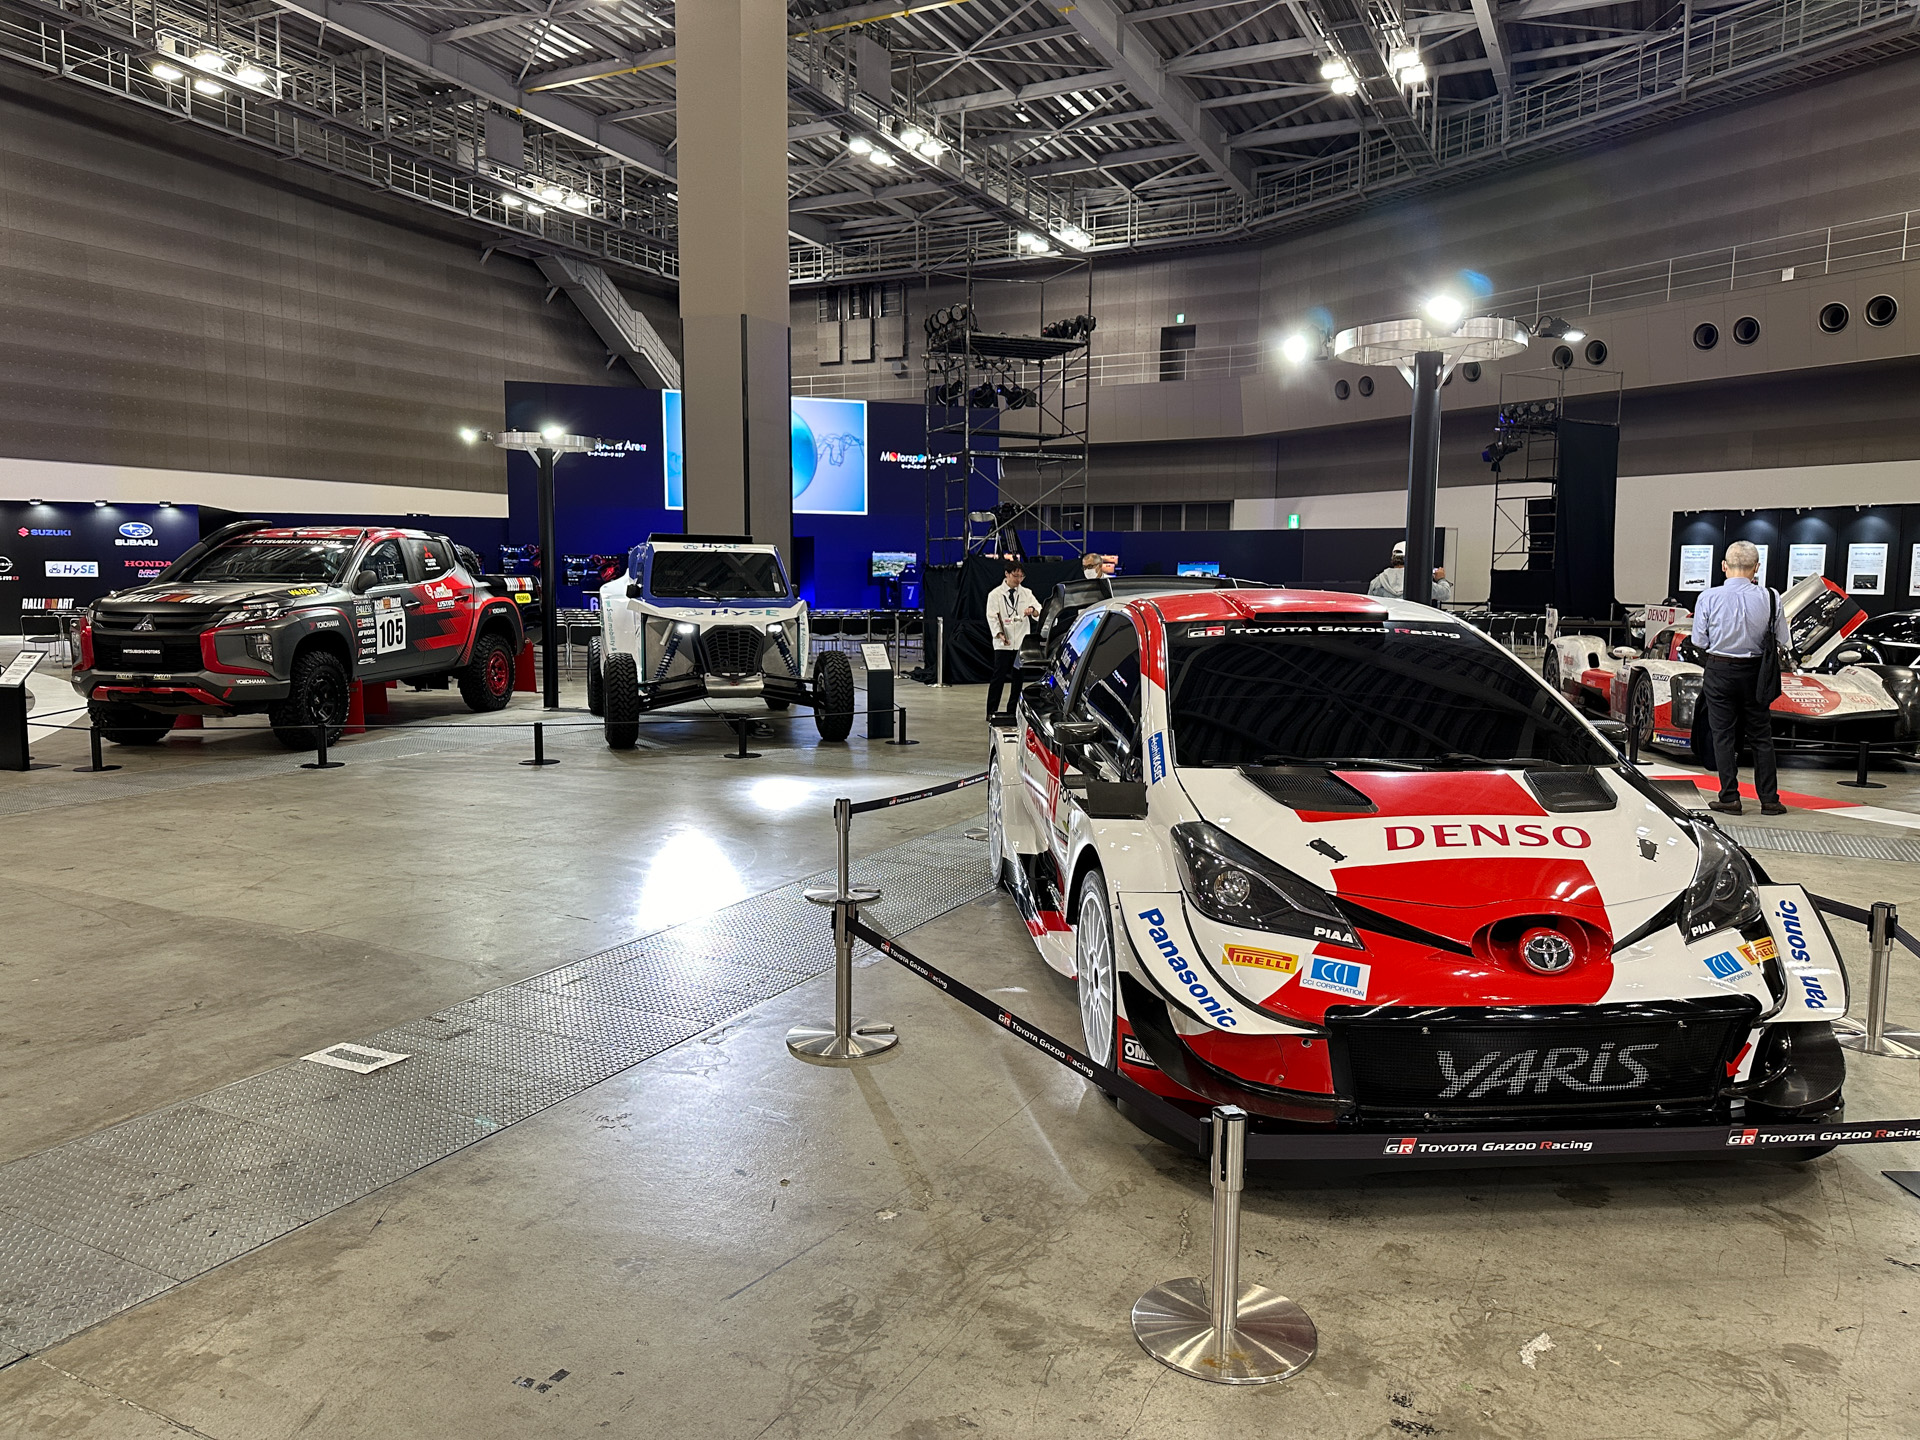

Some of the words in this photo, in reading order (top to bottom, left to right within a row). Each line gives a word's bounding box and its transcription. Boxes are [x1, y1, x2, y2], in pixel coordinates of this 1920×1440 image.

[63, 564, 95, 575] HySE
[907, 586, 914, 600] 7
[22, 598, 74, 609] RALLIART
[590, 597, 599, 611] 6
[1647, 608, 1668, 622] DENSO
[316, 620, 340, 629] YOKOHAMA
[379, 617, 403, 649] 105
[1189, 629, 1224, 638] GR
[1230, 626, 1313, 635] TOYOTA
[1317, 625, 1390, 634] GAZOO
[1394, 628, 1461, 639] Racing
[1383, 824, 1592, 851] DENSO
[1313, 926, 1354, 944] PIAA
[1690, 920, 1716, 937] PIAA
[1227, 947, 1293, 970] PIRELLI
[1775, 899, 1829, 1010] Pansonic
[880, 942, 890, 953] GR
[890, 948, 909, 965] TOYOTA
[909, 960, 929, 976] GAZOO
[928, 971, 948, 989] Racing
[1138, 907, 1237, 1028] Panasonic
[1321, 962, 1348, 984] CCI
[1712, 954, 1737, 975] CCI
[1302, 978, 1315, 986] CCI
[1316, 981, 1365, 997] CORPORATION
[998, 1012, 1011, 1027] GR
[1011, 1021, 1038, 1042] TOYOTA
[1039, 1038, 1066, 1059] GAZOO
[1066, 1054, 1094, 1078] Racing
[1125, 1042, 1151, 1061] OM
[1385, 1143, 1412, 1153] GR
[1418, 1143, 1477, 1153] TOYOTA
[1481, 1142, 1537, 1151] GAZOO
[1539, 1140, 1593, 1151] Racing
[1728, 1136, 1755, 1145] GR
[1759, 1133, 1816, 1143] TOYOTA
[1819, 1131, 1872, 1141] GAZOO
